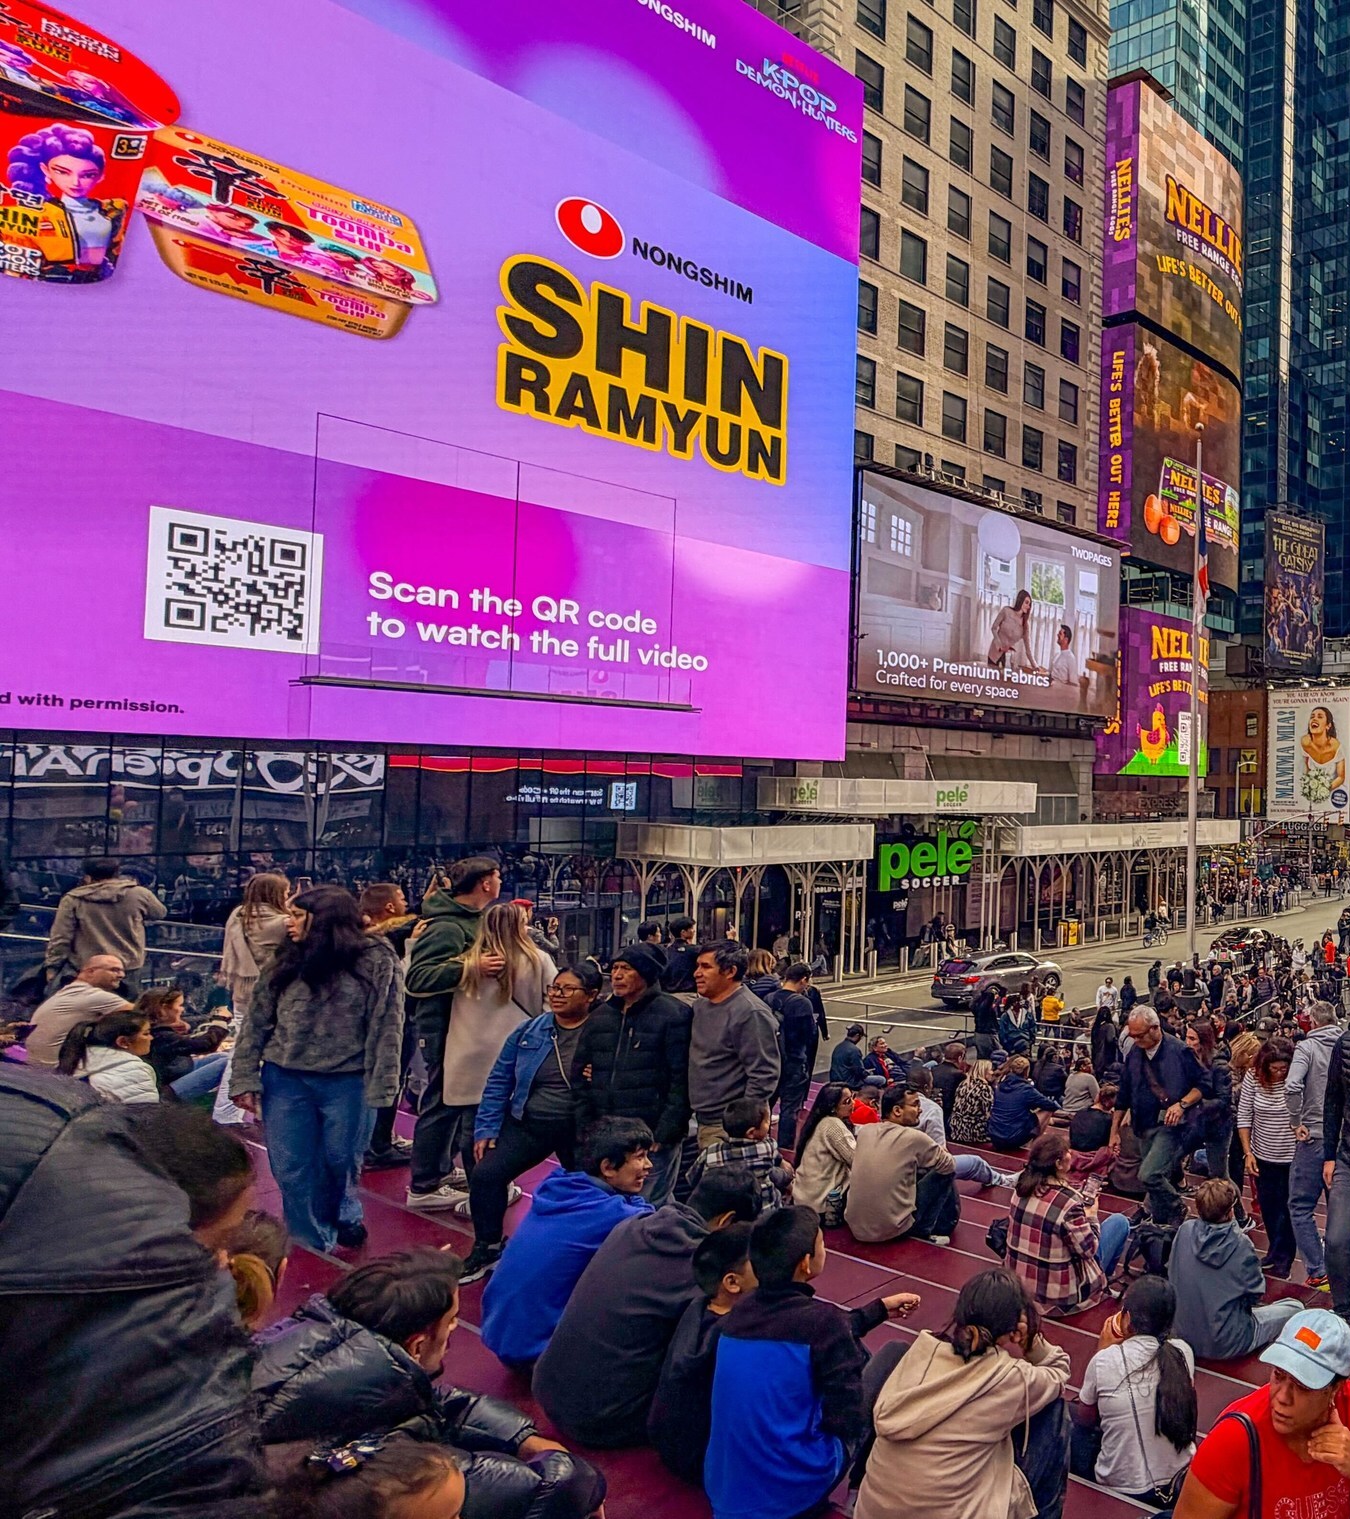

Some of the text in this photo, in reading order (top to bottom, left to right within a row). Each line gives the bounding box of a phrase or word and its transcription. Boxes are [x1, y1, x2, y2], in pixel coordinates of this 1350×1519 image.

[638, 0, 716, 49] NGSHIM
[0, 208, 39, 228] HIN
[1114, 157, 1134, 242] NELLIE'S
[307, 209, 414, 256] Toomba
[1176, 229, 1231, 275] FREE RANGE
[632, 237, 753, 305] NONGSHIM
[1156, 254, 1239, 325] LIFE'S BETTER OUT
[504, 261, 784, 430] SHIN
[1109, 351, 1125, 392] LIFE'S
[504, 350, 782, 480] RAMYUN
[1109, 454, 1122, 484] OUT
[1169, 469, 1221, 506] NELIE'S
[1105, 490, 1121, 529] HERE
[1070, 546, 1112, 568] TWOPAGES
[1273, 534, 1318, 561] THE GREAT
[1278, 553, 1315, 573] GATSBY
[368, 571, 658, 635] Scan the QR code
[366, 611, 708, 672] to watch the full video
[1151, 625, 1209, 669] NELIE
[875, 669, 1019, 700] Crafted for every space
[876, 649, 1050, 688] 1,000+ Premium Fabrics
[1159, 661, 1179, 673] FREE
[17, 693, 185, 714] with permission.
[1148, 680, 1171, 698] LIFE'S
[1276, 710, 1296, 743] MIA!
[1275, 745, 1295, 799] MAMMA
[1138, 797, 1180, 809] EXPRESS
[901, 874, 960, 891] SOCCER
